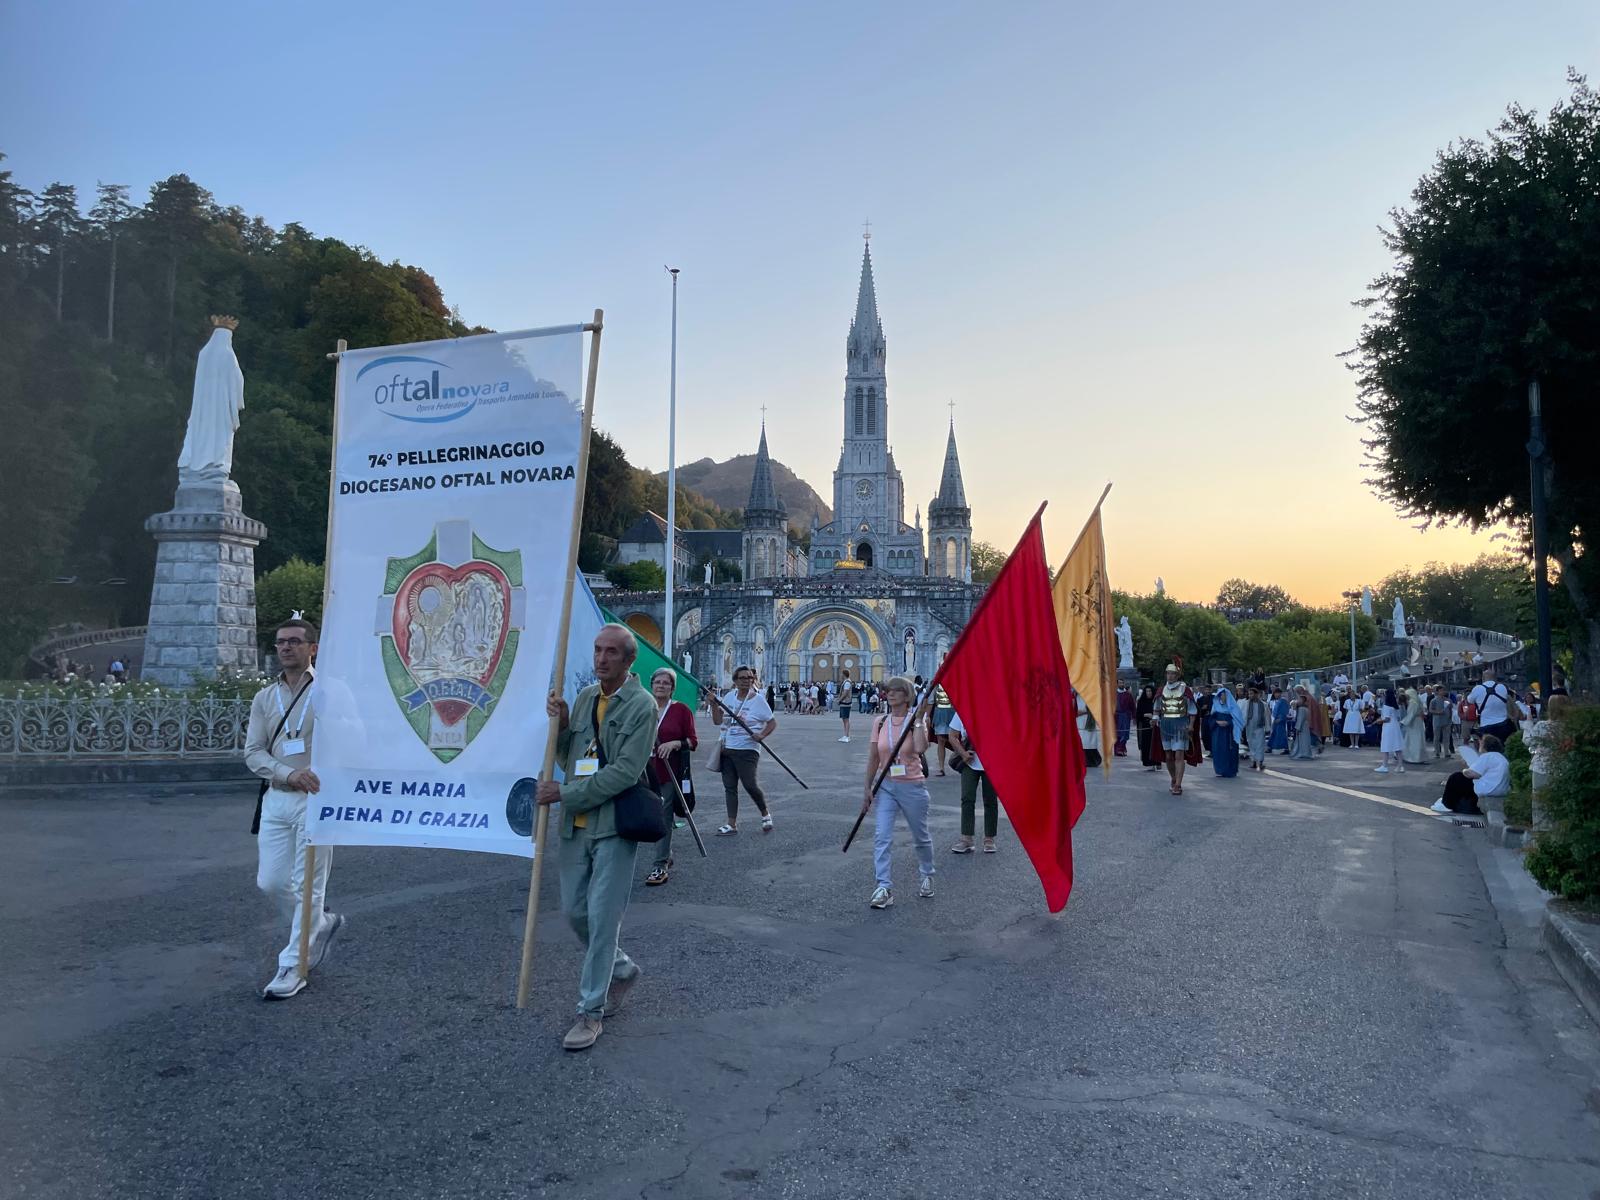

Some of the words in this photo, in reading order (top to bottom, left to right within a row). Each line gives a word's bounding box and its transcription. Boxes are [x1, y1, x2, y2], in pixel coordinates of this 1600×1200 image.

[374, 370, 440, 405] oftal
[441, 380, 510, 400] novara
[368, 453, 393, 469] 74°
[397, 440, 545, 466] PELLEGRINAGGIO
[339, 475, 436, 495] DIOCESANO
[440, 471, 496, 489] OFTAL
[500, 465, 576, 485] NOVARA
[353, 779, 393, 795] AVE
[400, 781, 467, 798] MARIA
[319, 806, 383, 823] PIENA
[390, 809, 413, 825] DI
[418, 810, 489, 829] GRAZIA
